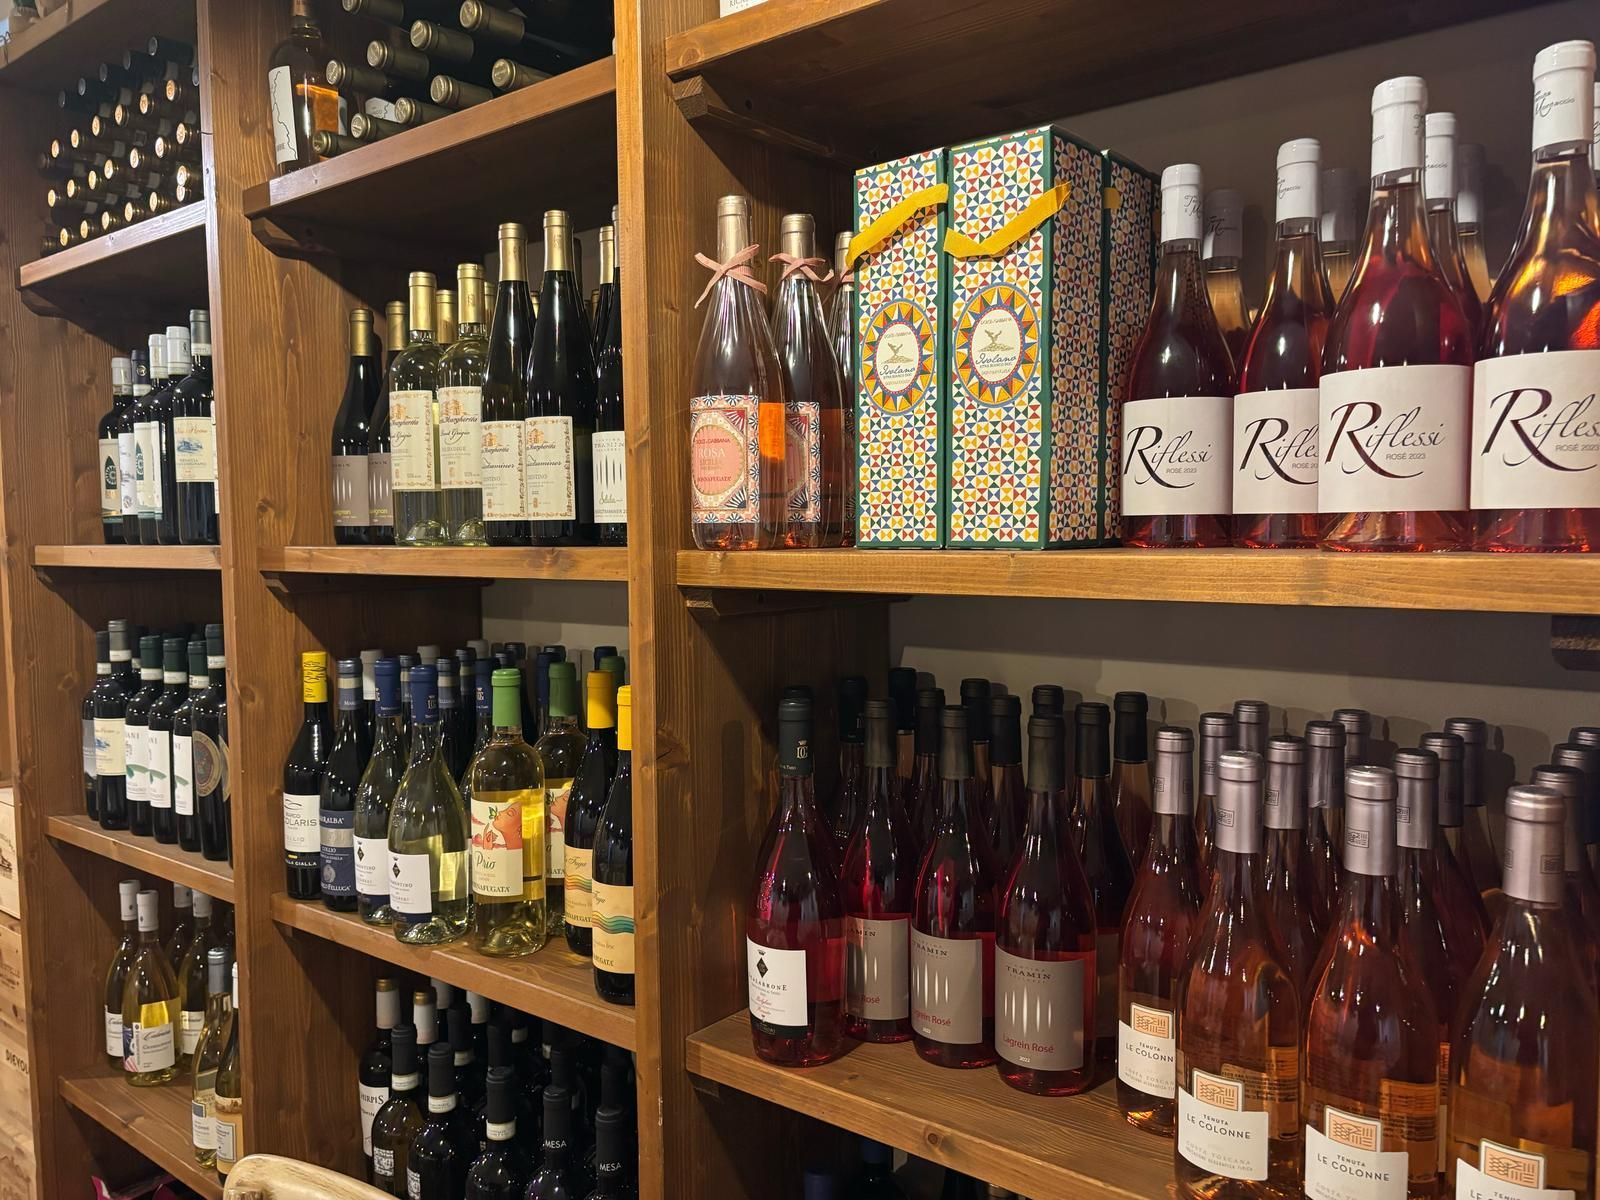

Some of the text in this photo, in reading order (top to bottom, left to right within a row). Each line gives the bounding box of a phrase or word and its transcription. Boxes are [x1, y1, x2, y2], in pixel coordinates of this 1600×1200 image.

[975, 353, 1017, 365] Isolano
[1325, 401, 1446, 479] Riflessi
[1123, 425, 1214, 489] Riflessi
[1386, 452, 1407, 460] ROSÉ
[475, 851, 496, 869] Prio
[1006, 965, 1051, 979] TRAMIN
[932, 1015, 951, 1027] Rosé
[1003, 1033, 1054, 1054] Lagrein Rosé
[1139, 1042, 1160, 1051] TENUTA
[1126, 1043, 1173, 1062] LE COLONN
[1187, 1113, 1251, 1139] LE COLONNE
[1203, 1114, 1229, 1126] TENUTA
[545, 1139, 567, 1149] MESA
[600, 1162, 621, 1172] MESA
[1317, 1153, 1390, 1181] LE COLONNE
[1337, 1154, 1366, 1167] TENUTA
